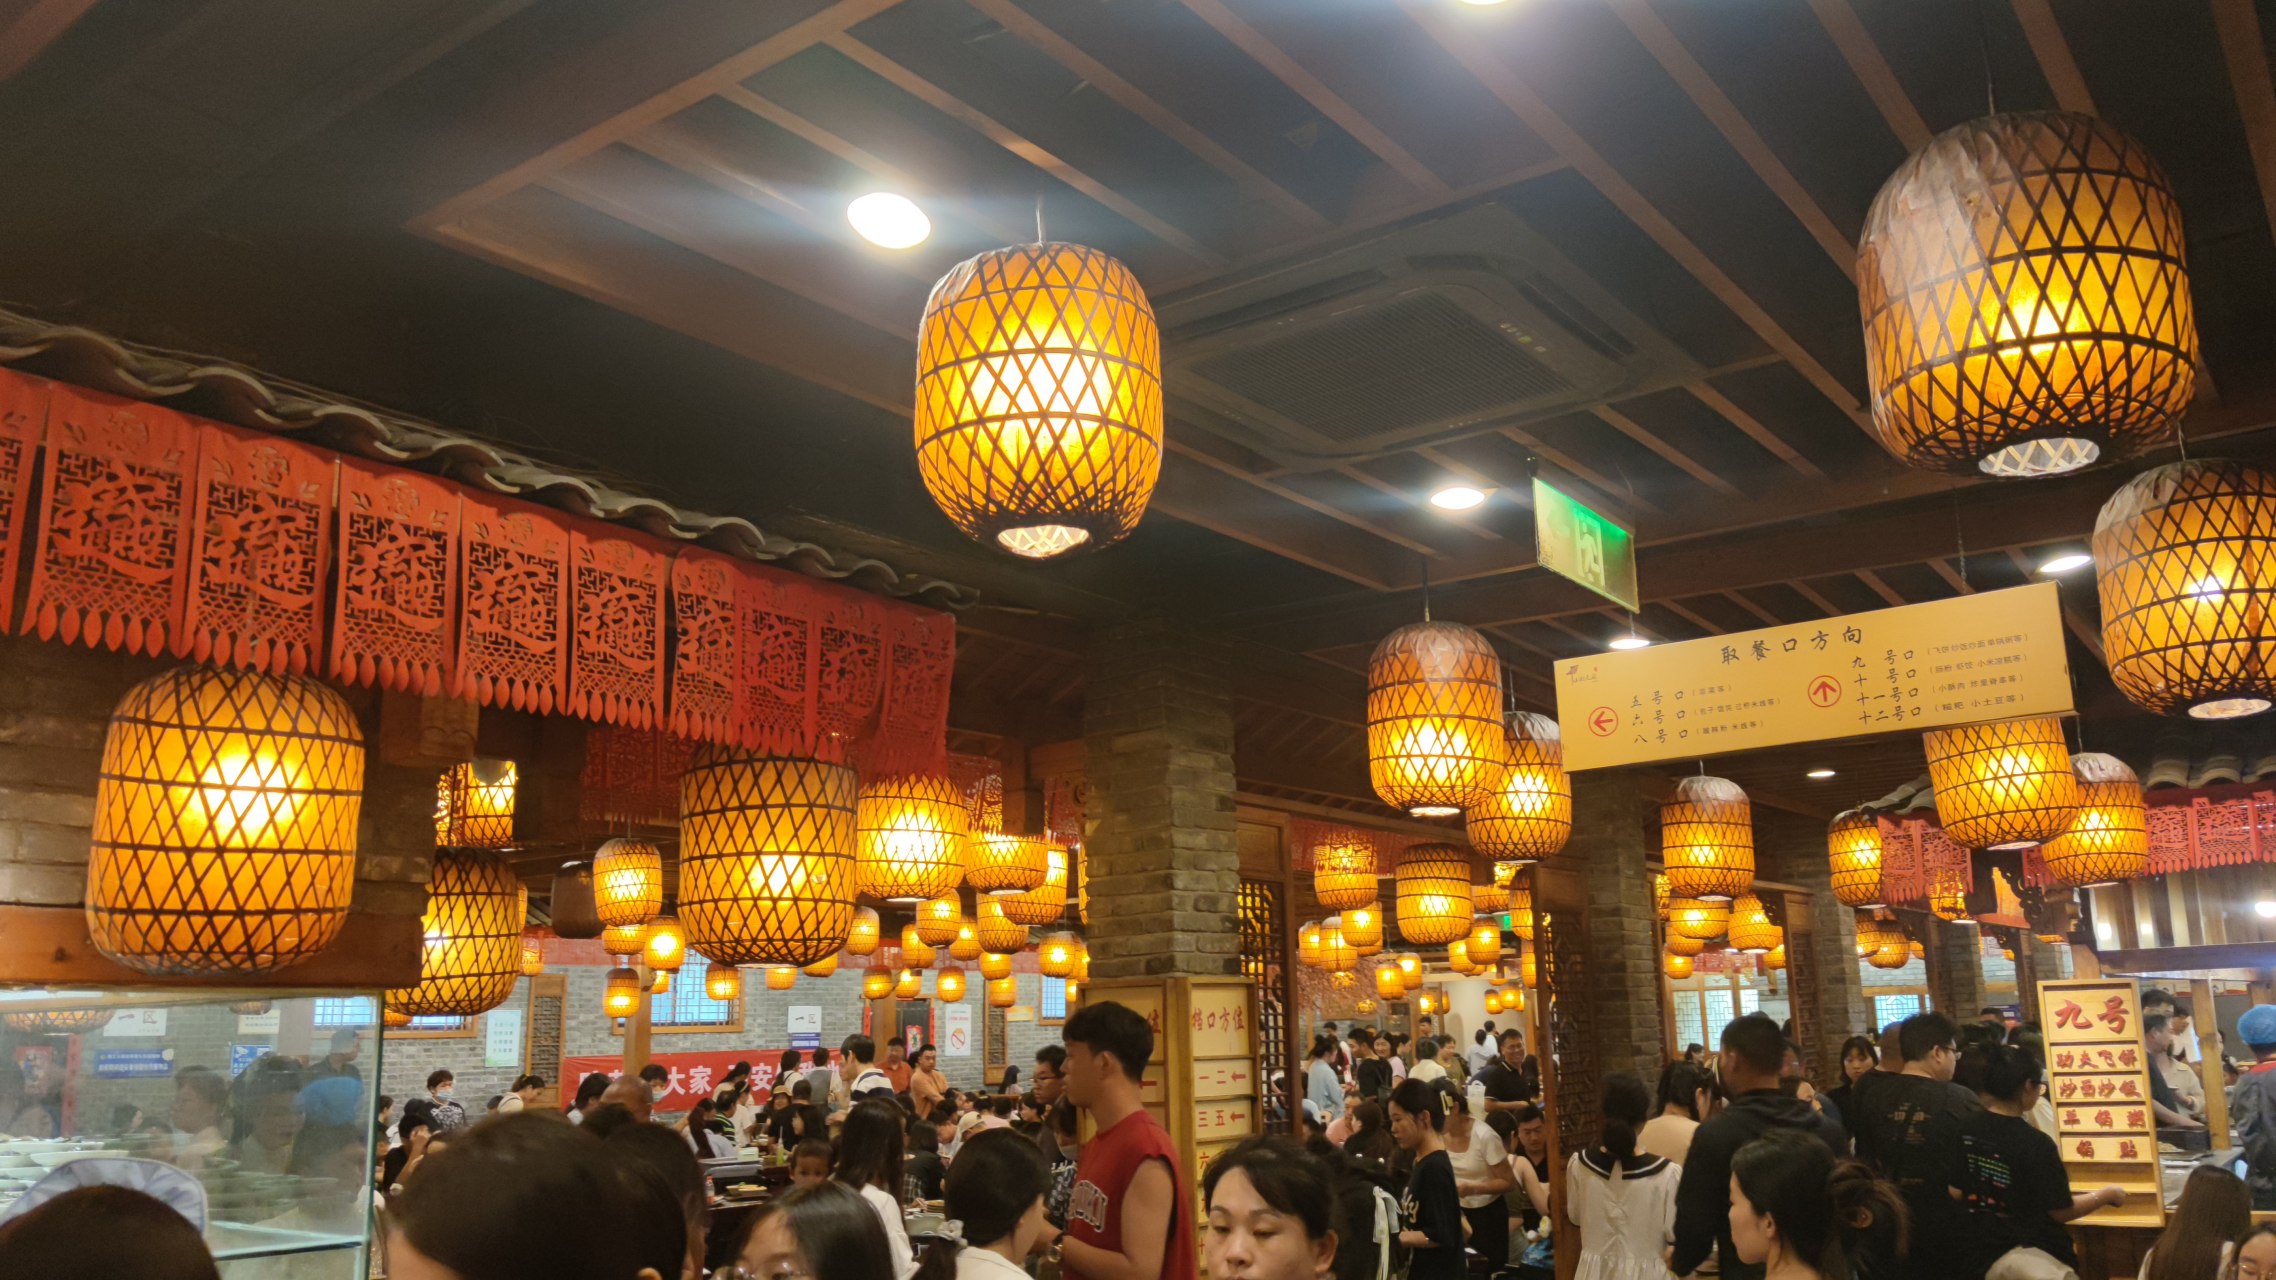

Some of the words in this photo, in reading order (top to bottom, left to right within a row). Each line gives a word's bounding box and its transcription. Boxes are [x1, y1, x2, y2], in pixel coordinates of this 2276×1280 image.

[1720, 625, 1863, 665] 取餐口方向
[1851, 649, 1915, 670] 九号口
[1854, 668, 1918, 688] 十号口
[1630, 690, 1686, 709] 五号口
[1856, 687, 1920, 706] 十一号口
[1632, 710, 1686, 727] 六号口
[1858, 706, 1922, 725] 十二号口
[1633, 729, 1689, 745] 八号口
[1191, 1005, 1245, 1032] 档口方位
[2055, 995, 2130, 1034] 九号
[2056, 1047, 2138, 1069] 功夫飞饼
[2059, 1077, 2142, 1098] 炒面炒饭
[2076, 1139, 2138, 1159] 锅贴
